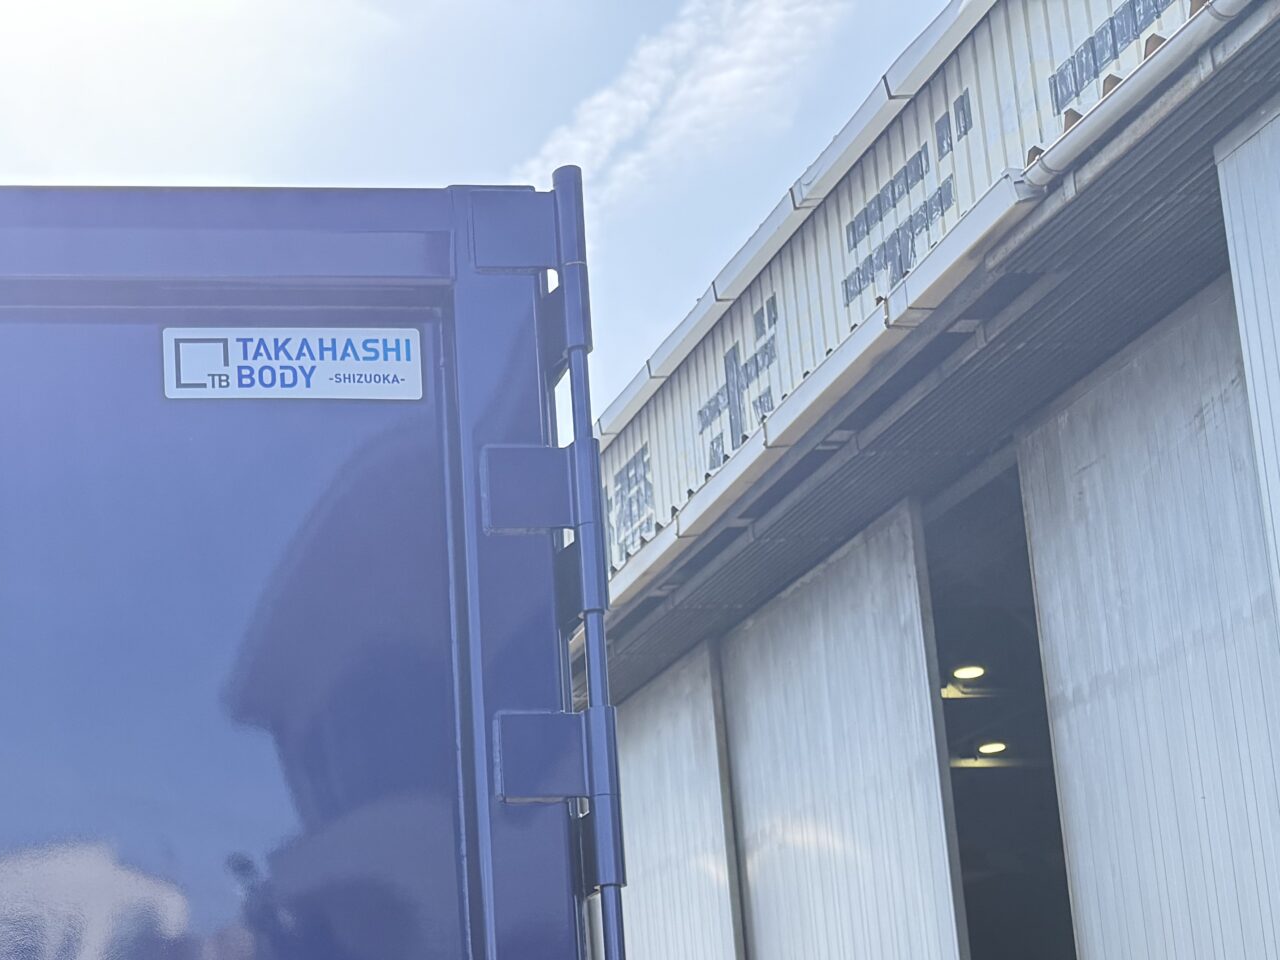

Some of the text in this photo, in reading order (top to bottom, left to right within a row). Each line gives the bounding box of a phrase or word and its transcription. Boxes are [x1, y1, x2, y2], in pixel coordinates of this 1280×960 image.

[236, 338, 412, 361] TAKAHASHI
[207, 373, 230, 388] TB
[237, 365, 316, 389] BODY
